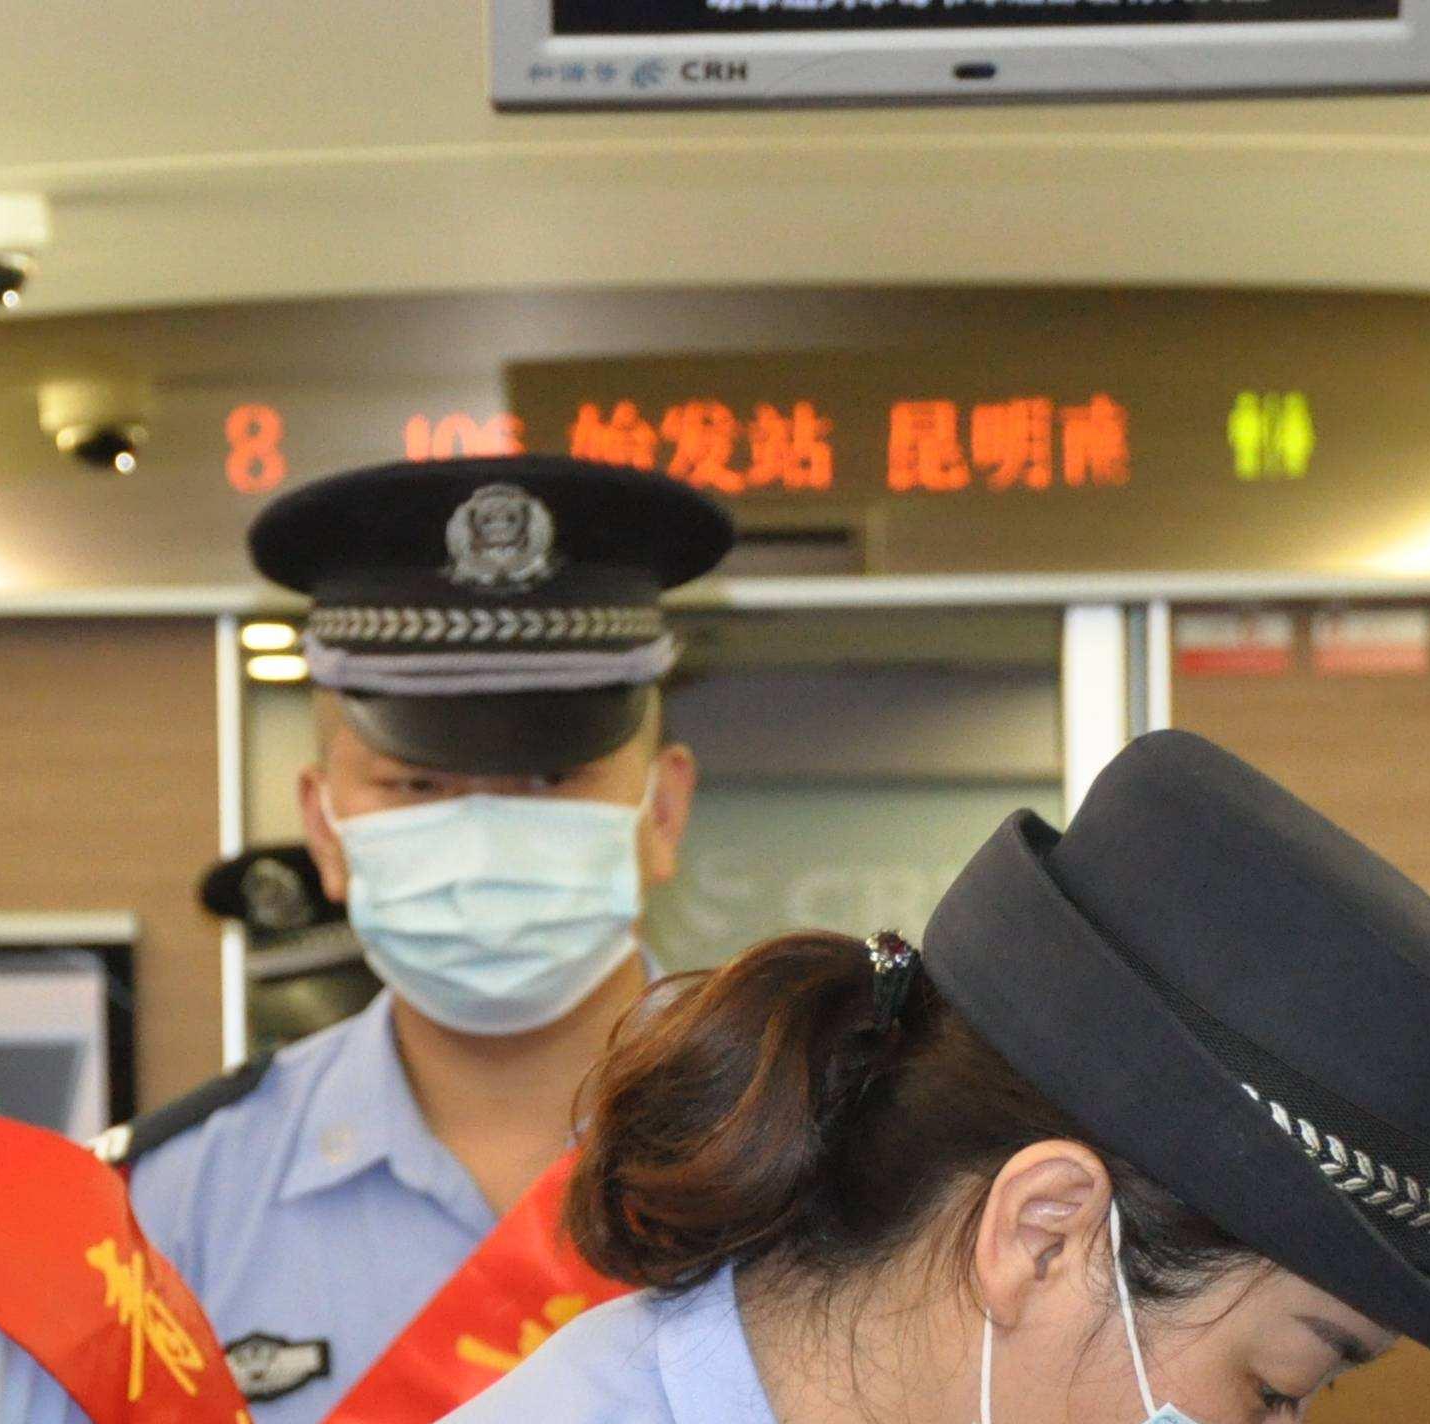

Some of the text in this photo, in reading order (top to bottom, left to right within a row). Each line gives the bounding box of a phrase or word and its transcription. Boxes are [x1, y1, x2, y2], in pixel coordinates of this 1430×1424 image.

[681, 60, 749, 82] CRH
[886, 394, 1130, 493] 昆明南
